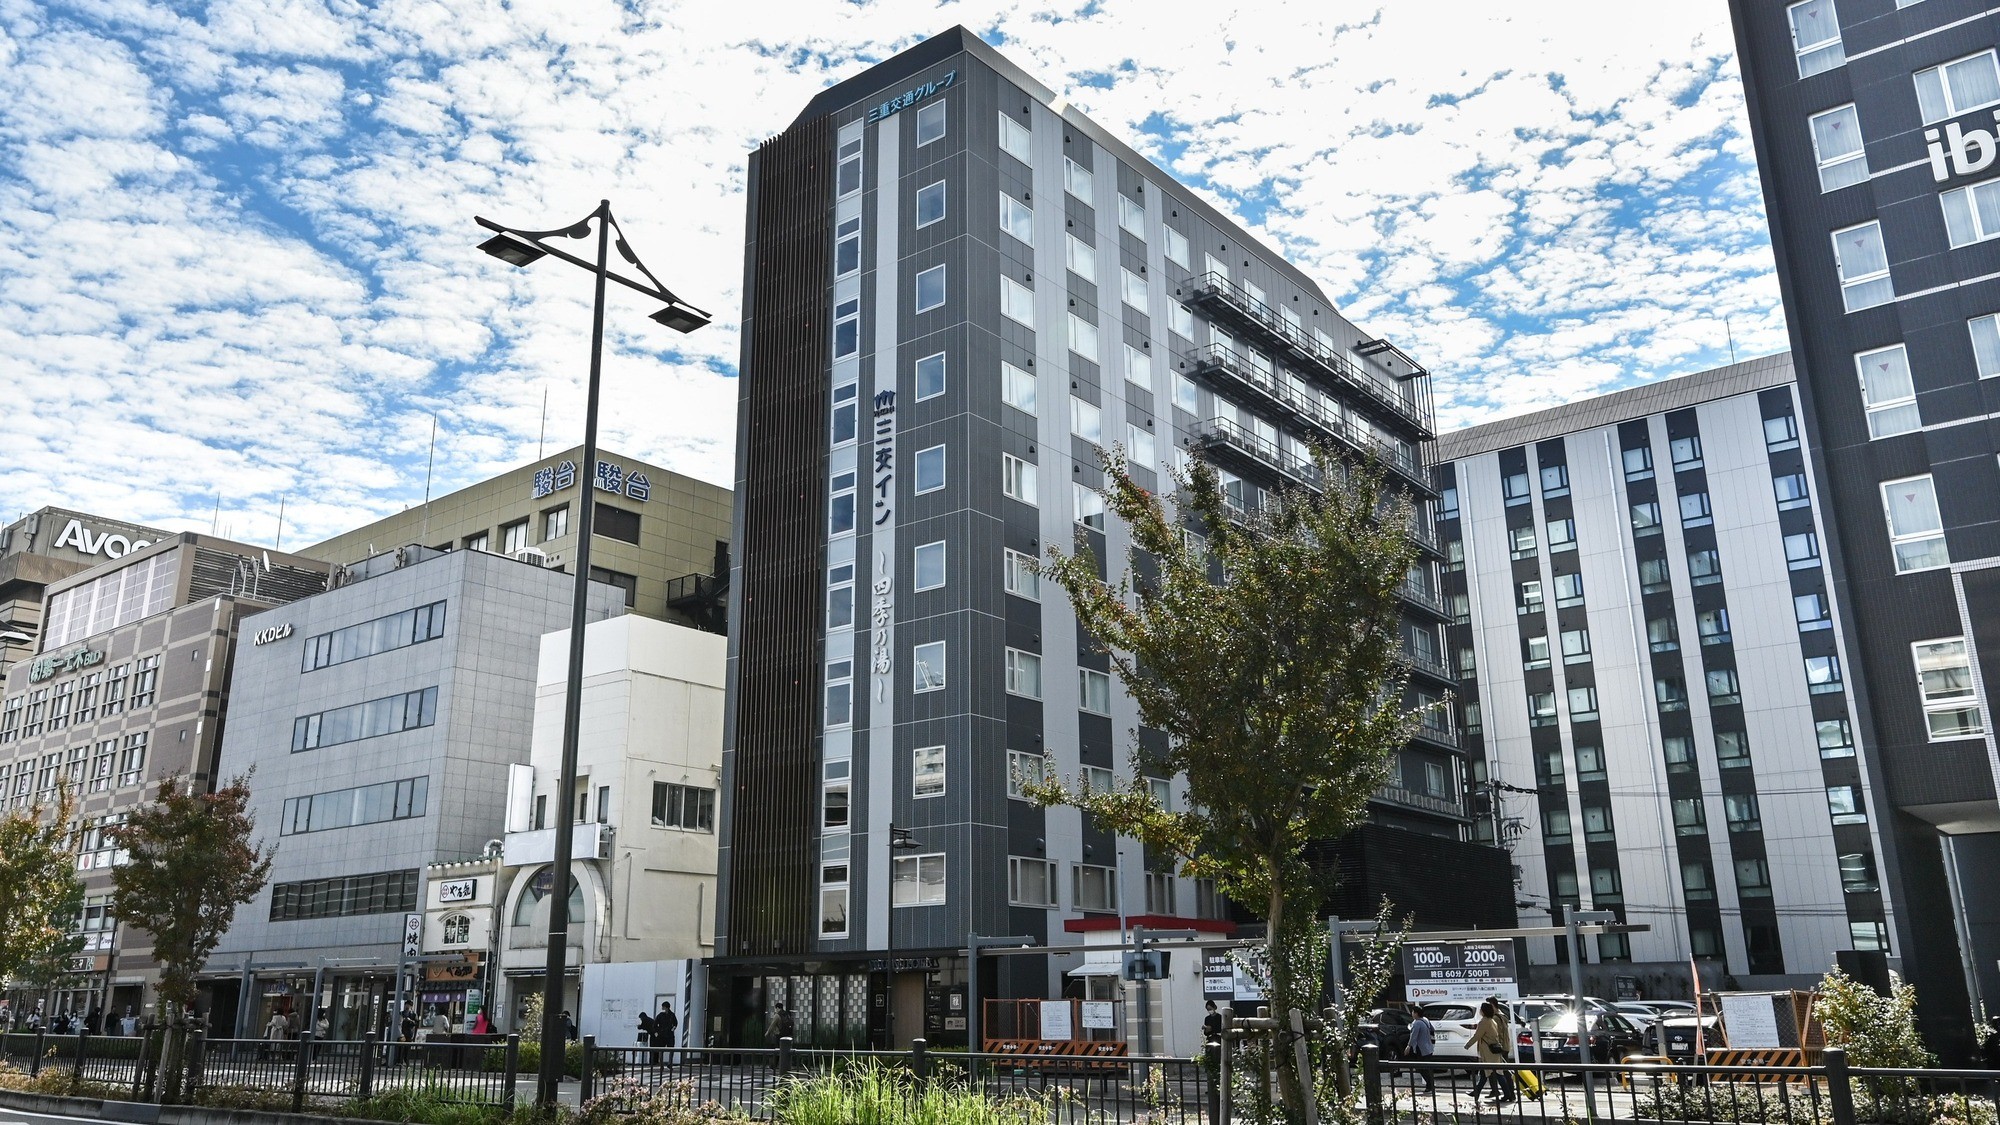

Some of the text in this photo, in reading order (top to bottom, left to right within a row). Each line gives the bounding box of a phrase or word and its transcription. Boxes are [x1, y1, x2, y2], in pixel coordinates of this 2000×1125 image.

[868, 69, 955, 122] 三重交通グループ
[1924, 109, 2000, 182] ib
[531, 460, 577, 500] 駿台
[593, 460, 652, 502] 駿台
[875, 418, 892, 526] 三交イン
[254, 622, 294, 646] KKDビル
[1413, 952, 1451, 964] 1000円
[1464, 950, 1505, 963] 2000円
[1421, 988, 1448, 996] D-Parking
